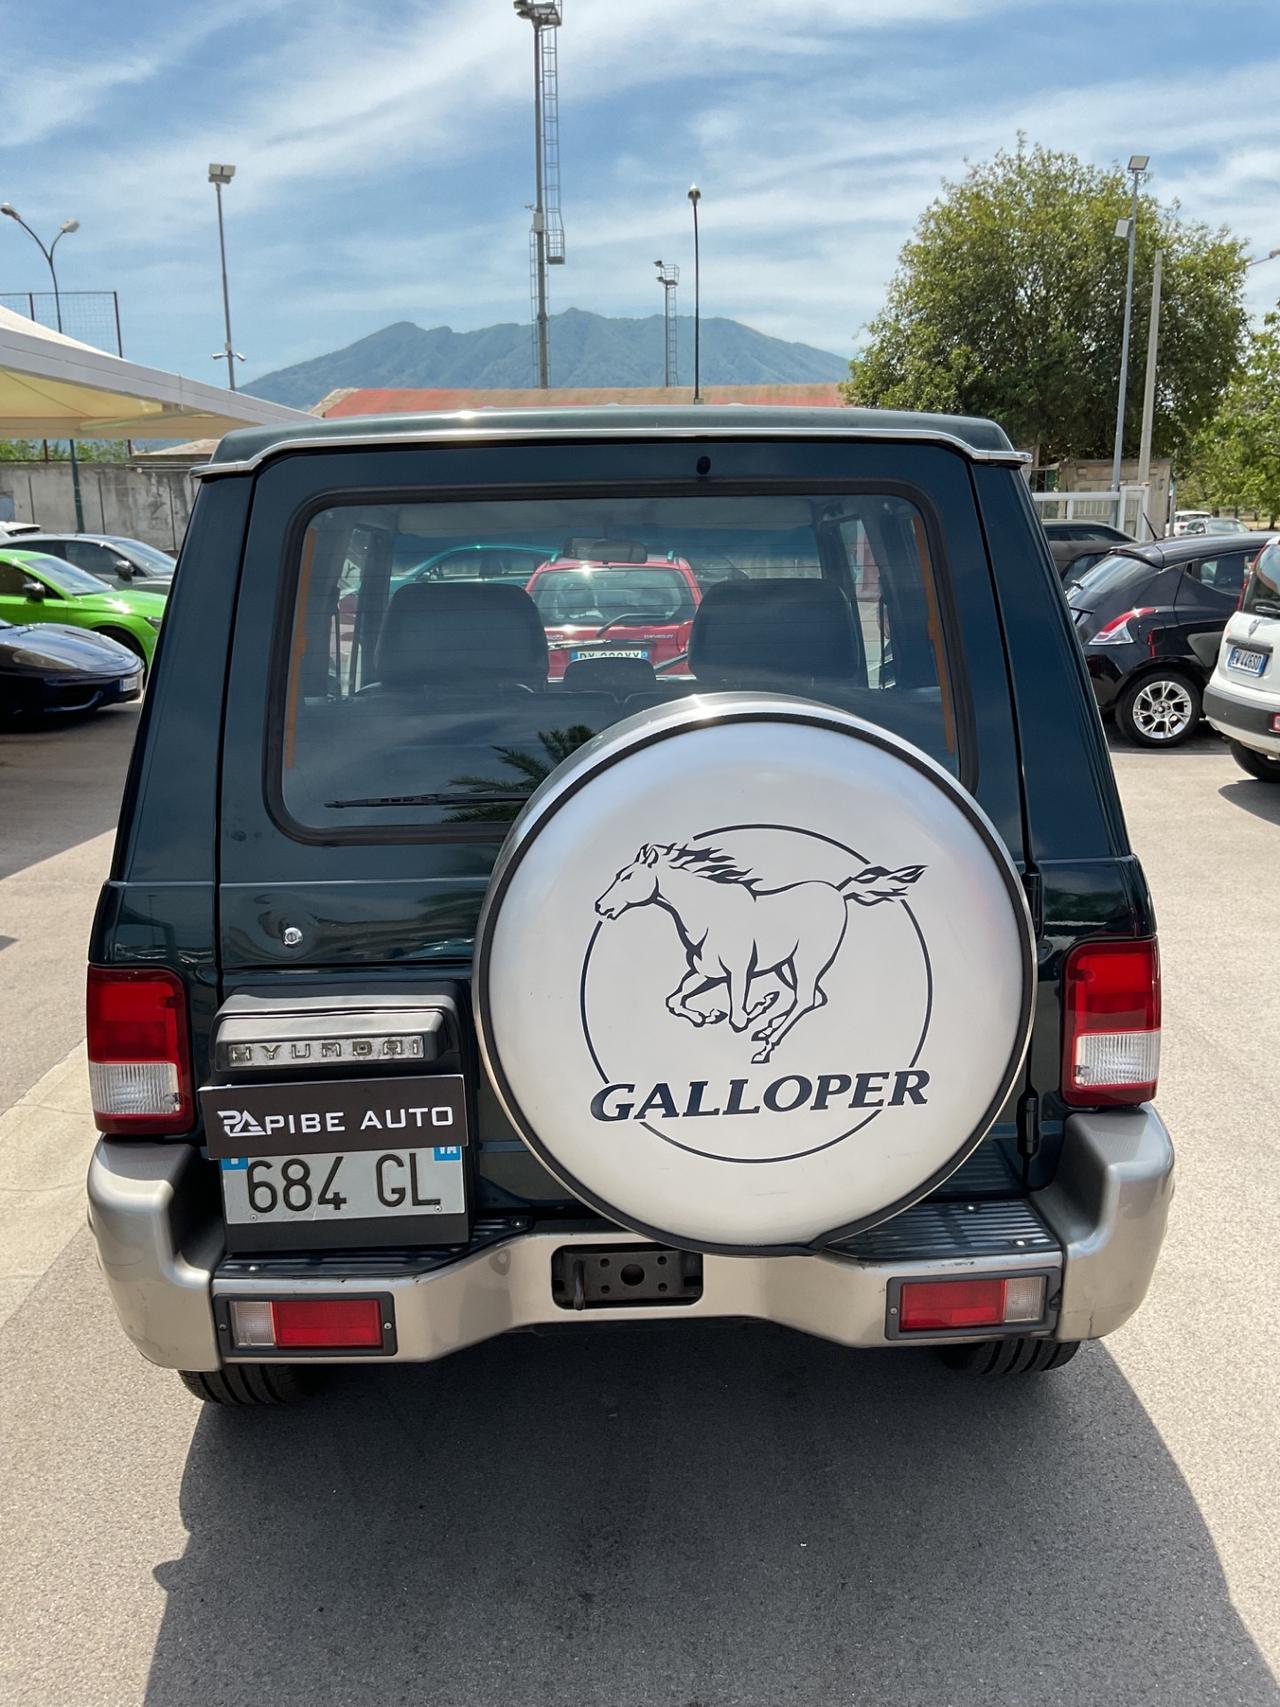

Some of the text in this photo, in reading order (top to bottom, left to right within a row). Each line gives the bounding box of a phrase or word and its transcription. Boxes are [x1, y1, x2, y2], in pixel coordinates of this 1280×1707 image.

[231, 1039, 420, 1061] HYUNDAI
[590, 1069, 931, 1123] GALLOPER
[265, 1111, 346, 1135] PIBE
[360, 1106, 454, 1130] AUTO
[246, 1152, 441, 1213] 684 GL
